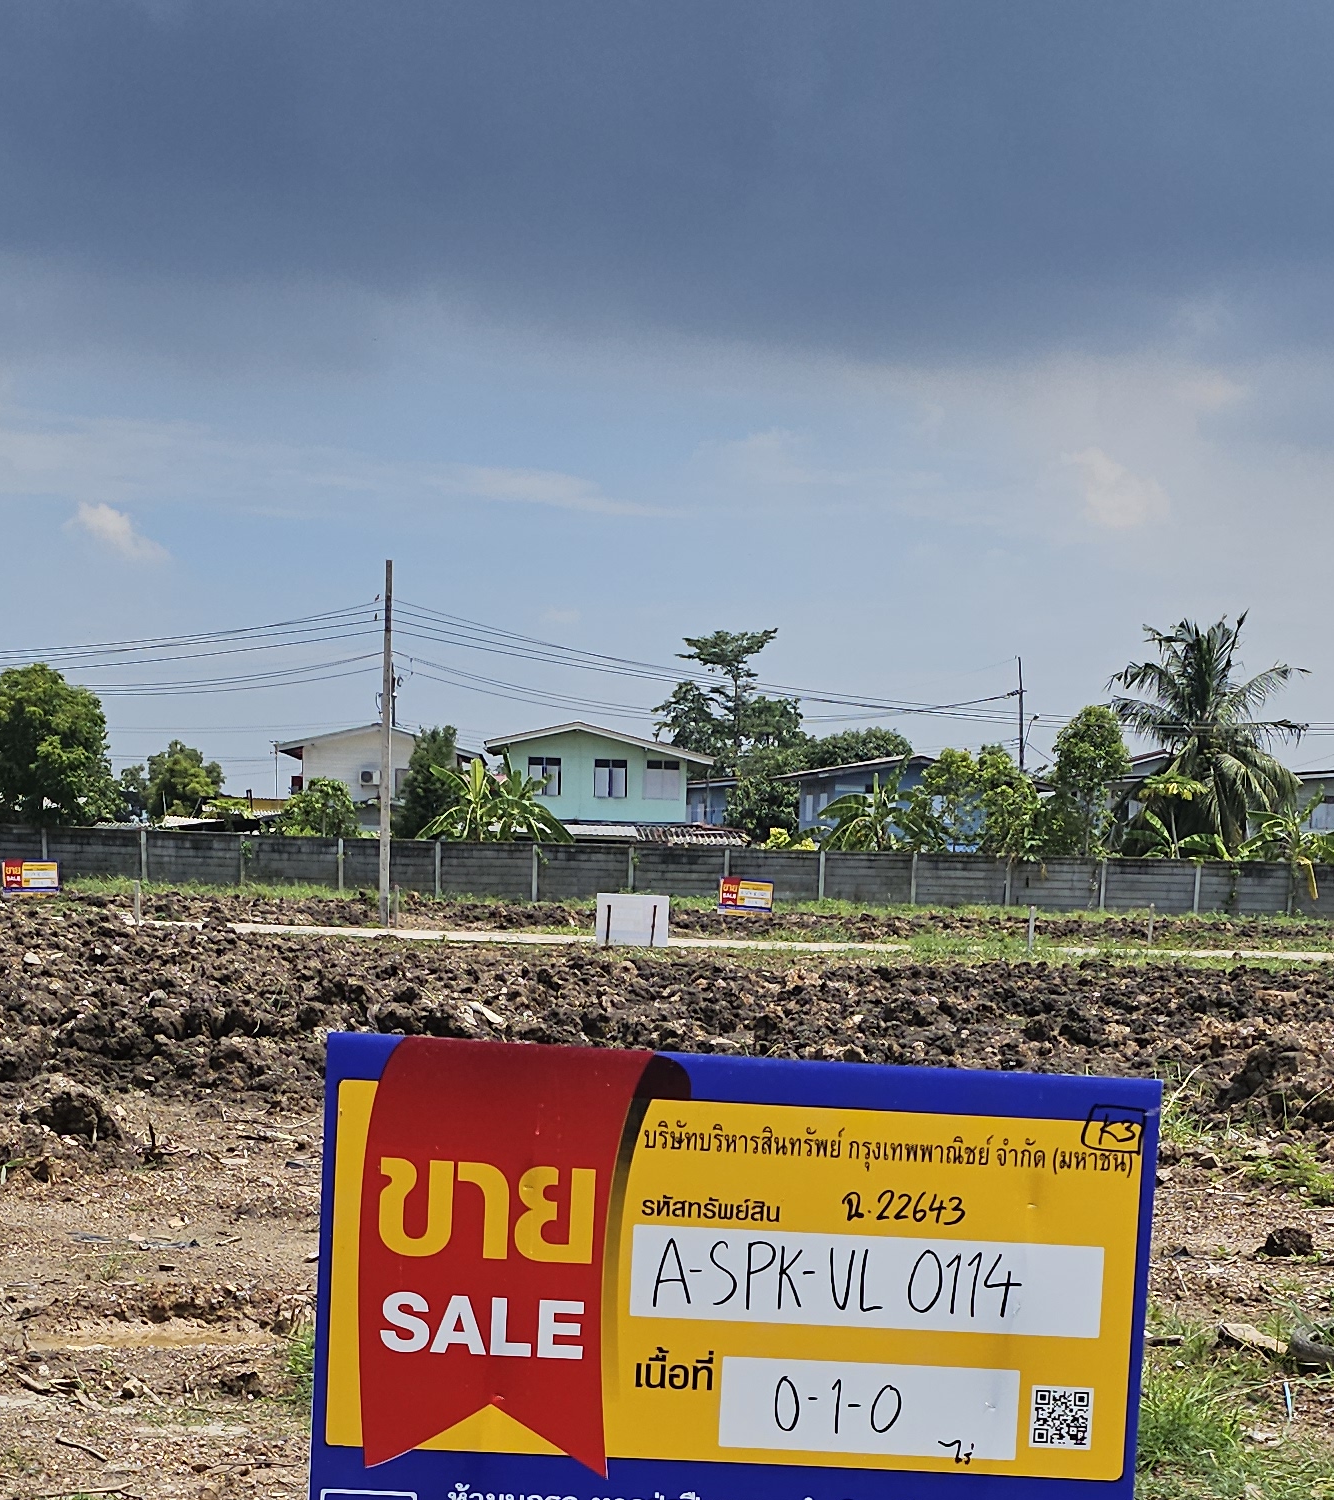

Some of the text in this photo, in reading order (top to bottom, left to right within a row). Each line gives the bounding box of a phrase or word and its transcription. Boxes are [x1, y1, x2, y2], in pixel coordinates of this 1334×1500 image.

[643, 1120, 1134, 1178] บริษัทบริหารสินทรัพย์ กรุงเทพพาณิชย์ จำกัด (มหาชน)
[378, 1156, 597, 1265] ขาย
[641, 1194, 781, 1223] รหัสทรัพย์สิน
[907, 1249, 1023, 1318] 0114
[379, 1291, 585, 1360] SALE
[634, 1346, 715, 1391] เนื้อที่
[773, 1375, 903, 1435] 0-1-0
